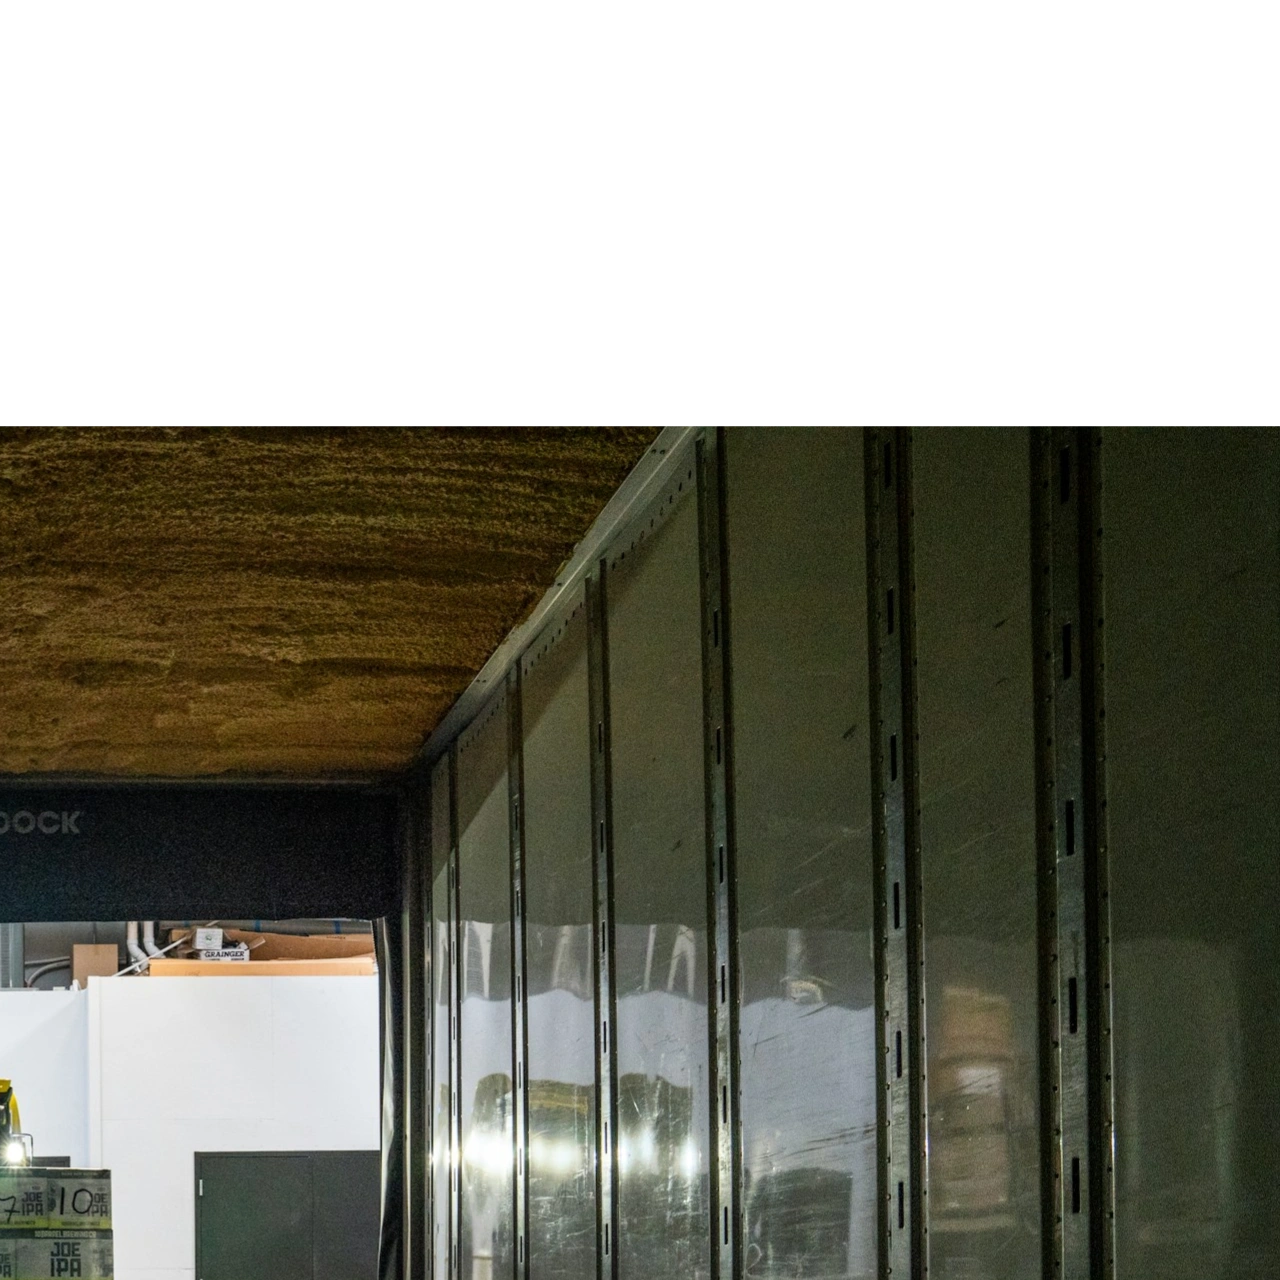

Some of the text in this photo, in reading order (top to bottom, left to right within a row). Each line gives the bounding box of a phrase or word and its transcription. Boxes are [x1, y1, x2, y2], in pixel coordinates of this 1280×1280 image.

[205, 950, 245, 958] GRAINGER
[22, 1192, 43, 1203] JOE
[60, 1187, 93, 1214] 10
[90, 1192, 108, 1203] OE
[22, 1203, 44, 1216] IPA
[50, 1242, 81, 1257] JOE
[50, 1258, 81, 1277] IPA
